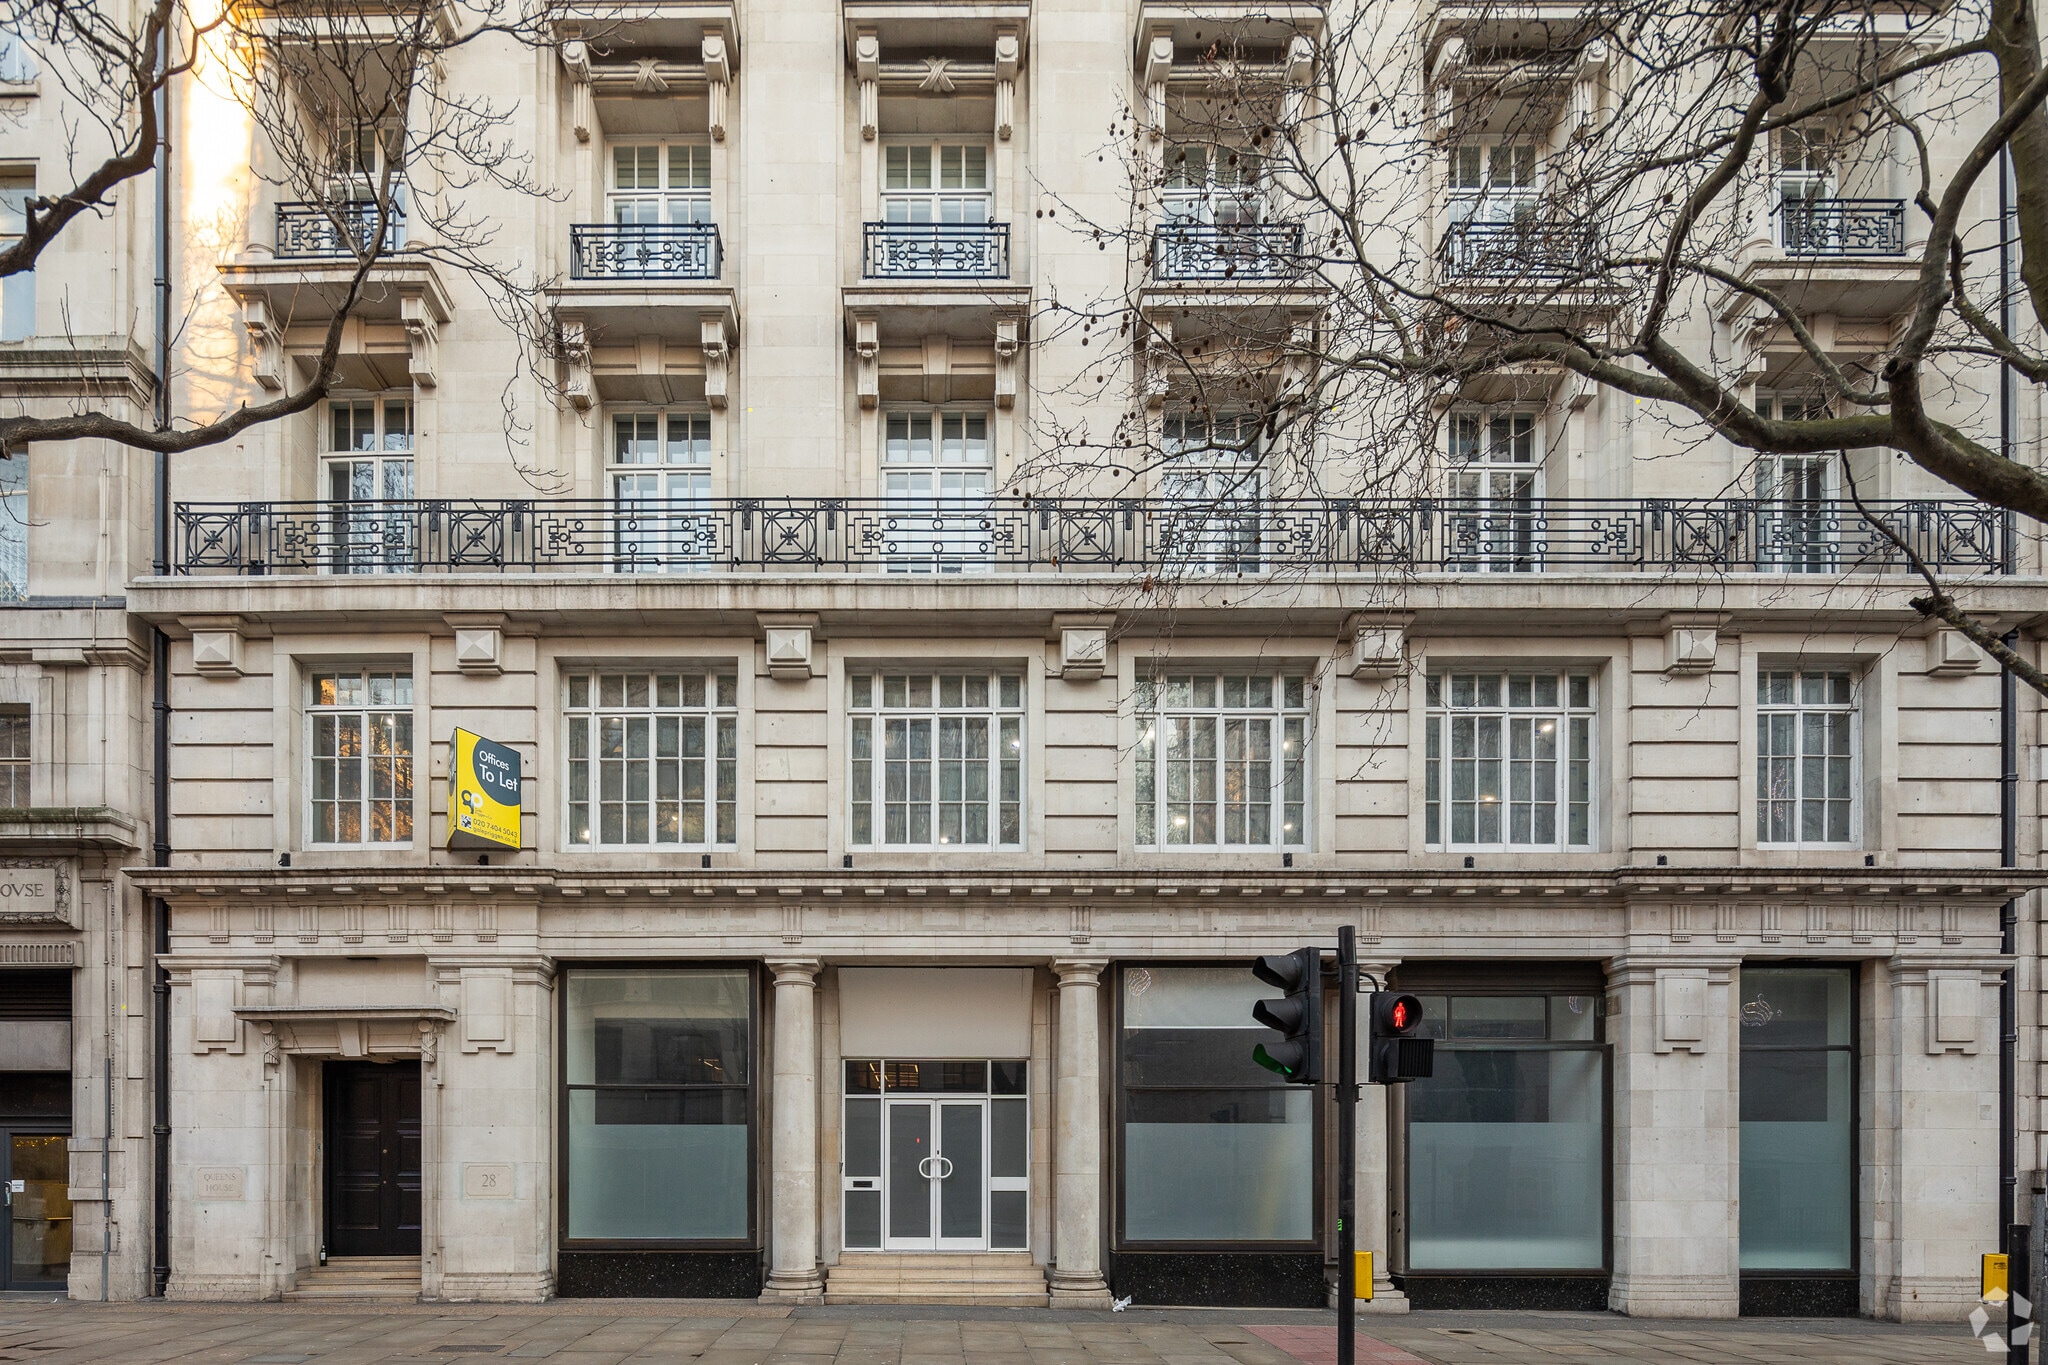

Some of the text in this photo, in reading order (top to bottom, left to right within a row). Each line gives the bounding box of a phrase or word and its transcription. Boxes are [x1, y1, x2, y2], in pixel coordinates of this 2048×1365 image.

[479, 750, 509, 771] Offices
[479, 763, 495, 783] To
[499, 771, 518, 791] Let
[473, 818, 518, 838] 020 7404 5043
[203, 1173, 236, 1182] QUEENS
[481, 1173, 497, 1188] 28
[205, 1183, 234, 1192] HOUSE
